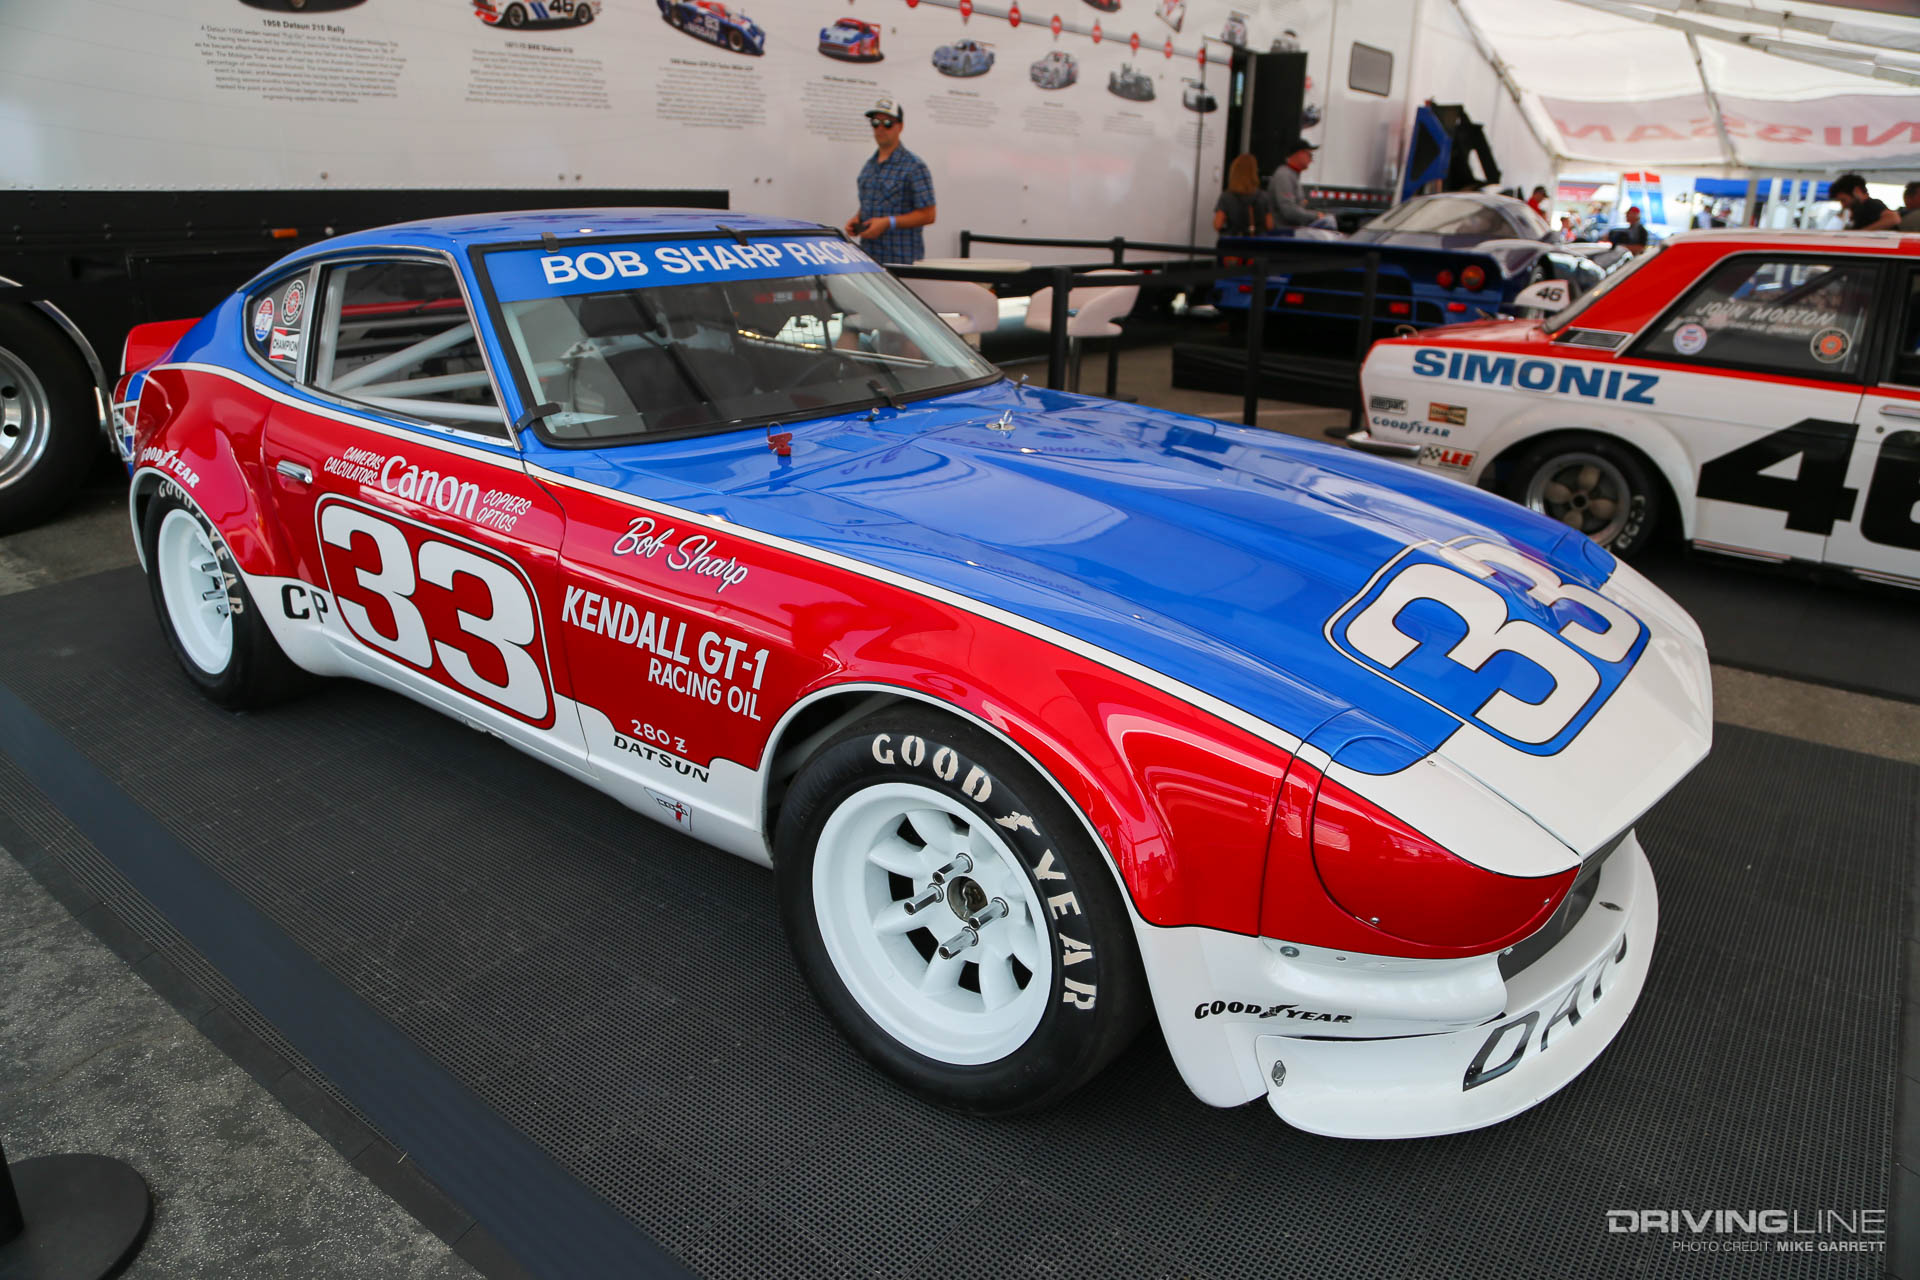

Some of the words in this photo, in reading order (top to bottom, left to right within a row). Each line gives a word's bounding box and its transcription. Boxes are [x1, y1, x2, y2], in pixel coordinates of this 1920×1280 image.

[283, 20, 310, 30] Datsun
[540, 250, 649, 285] BOB
[654, 242, 783, 274] SHARP
[1536, 287, 1565, 303] 46
[1695, 301, 1748, 320] JOHN
[1750, 304, 1838, 327] MORTON
[1412, 348, 1661, 405] SIMONIZ
[1372, 415, 1451, 438] GOODYEAR
[141, 446, 200, 489] GOODYEAR
[323, 456, 378, 486] CALCULATORS
[343, 446, 386, 471] CAMERAS
[1440, 449, 1473, 467] LEE
[380, 455, 480, 519] Canon
[482, 488, 533, 516] COPIERS
[476, 507, 517, 532] OPTICS
[613, 516, 675, 558] Bob
[666, 534, 749, 594] Sharp
[281, 584, 329, 624] CP
[321, 504, 548, 721] 33
[561, 584, 691, 666] KENDALL
[697, 630, 770, 691] GT-1
[1345, 542, 1641, 745] 33
[648, 657, 722, 706] RACING
[727, 685, 762, 722] OIL
[631, 719, 671, 746] 280
[673, 736, 688, 754] Z
[613, 734, 710, 784] DATSUN
[1194, 1000, 1353, 1024] GOODYEAR
